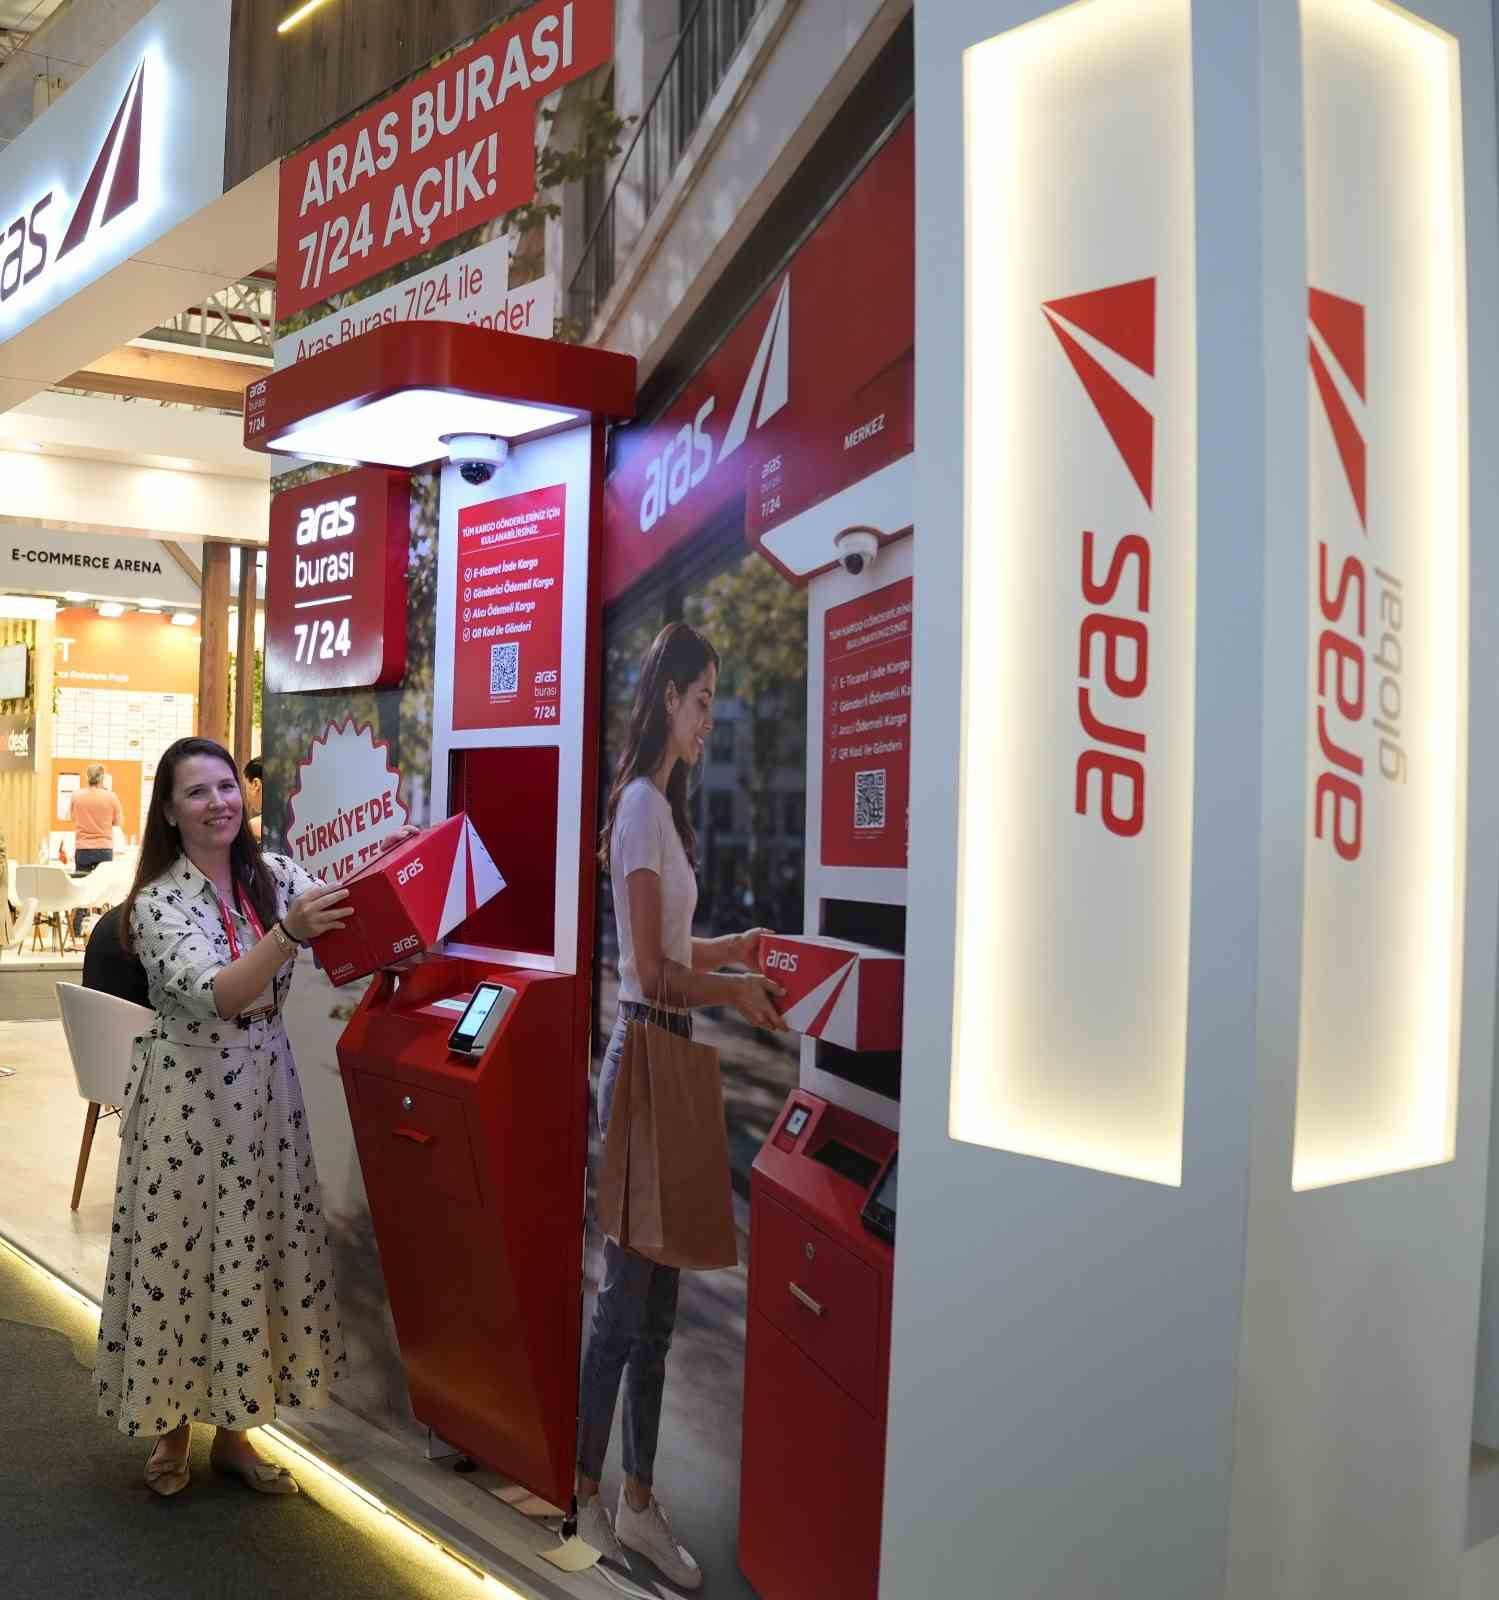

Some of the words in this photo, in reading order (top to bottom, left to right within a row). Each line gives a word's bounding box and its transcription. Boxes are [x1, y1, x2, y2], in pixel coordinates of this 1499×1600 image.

[299, 111, 400, 217] ARAS
[411, 2, 574, 153] BURASI
[298, 202, 374, 289] 7/24
[383, 131, 499, 245] AÇIK!
[0, 190, 53, 303] as
[296, 336, 334, 361] Aras
[340, 304, 399, 344] Burası
[404, 278, 452, 321] 7/24
[458, 264, 484, 300] ile
[465, 295, 536, 331] önder
[250, 380, 266, 398] aras
[249, 416, 265, 433] 7/24
[843, 413, 886, 450] MERKEZ
[640, 395, 715, 533] aras
[296, 496, 357, 546] aras
[11, 548, 110, 569] E-COMMERCE
[113, 558, 162, 574] ARENA
[295, 551, 354, 588] burası
[518, 558, 538, 570] Kargo
[504, 579, 532, 593] Ödemeli
[532, 577, 554, 589] Kargo
[515, 601, 536, 613] Kargo
[294, 618, 352, 665] 7/24
[534, 670, 557, 683] aras
[534, 686, 557, 697] burası
[1075, 531, 1151, 838] aras
[1372, 567, 1408, 785] global
[534, 706, 556, 719] 7/24
[1315, 541, 1366, 861] aras
[295, 790, 394, 862] TÜRKİYE'DE
[332, 853, 354, 881] VE
[396, 857, 424, 886] aras
[392, 933, 420, 954] aras
[766, 949, 799, 973] aras
